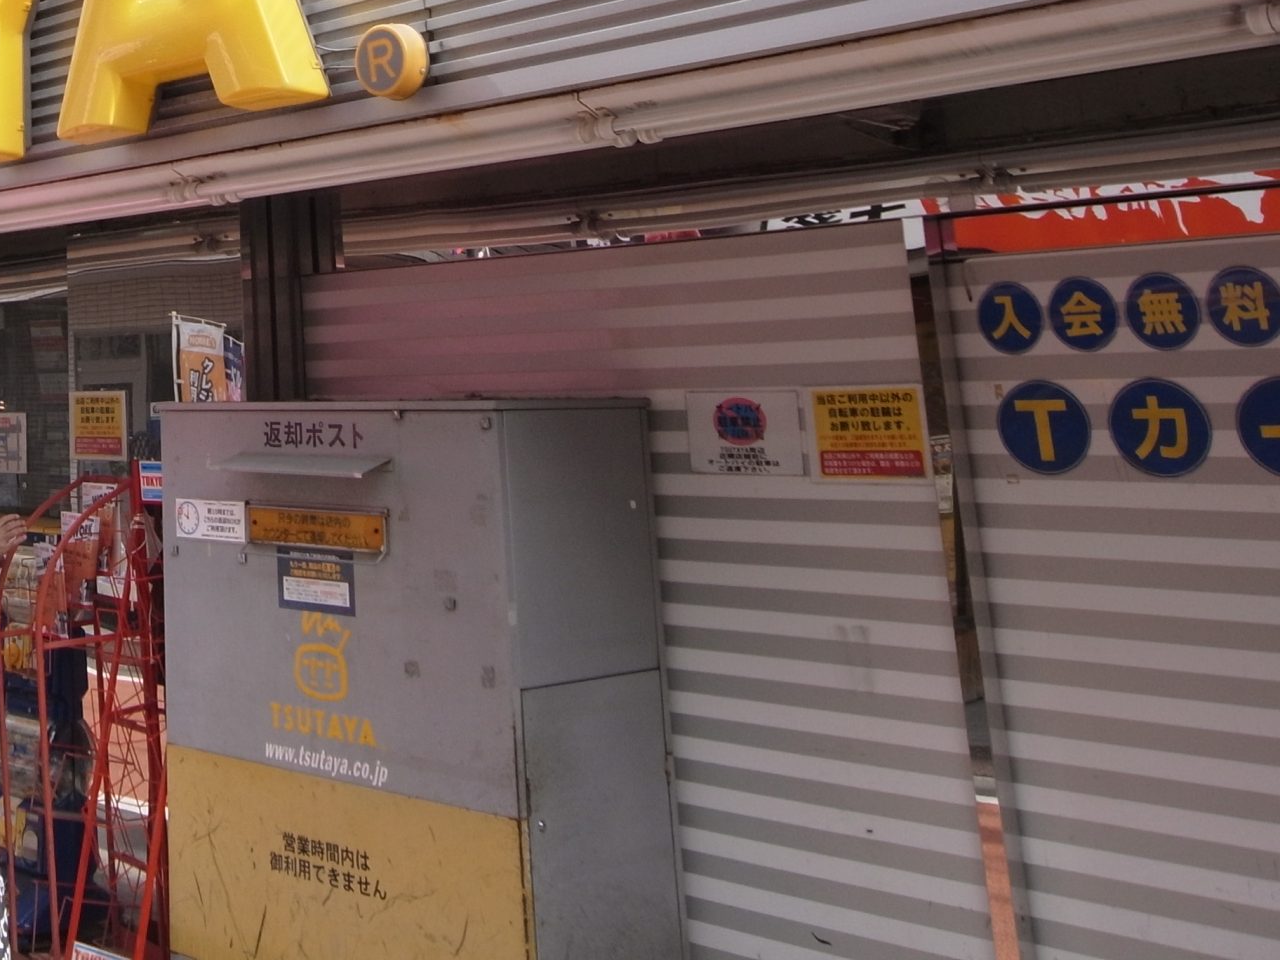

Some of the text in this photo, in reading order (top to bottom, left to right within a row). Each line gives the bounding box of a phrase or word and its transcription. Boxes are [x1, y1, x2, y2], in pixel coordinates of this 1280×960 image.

[991, 280, 1270, 341] 入会無料
[263, 420, 365, 450] 返却ポスト
[270, 701, 377, 748] TSUTAYA
[265, 742, 388, 787] www.tsutaya.co.jp
[283, 832, 371, 872] 営業時間内は
[269, 851, 388, 902] 御利用できません
